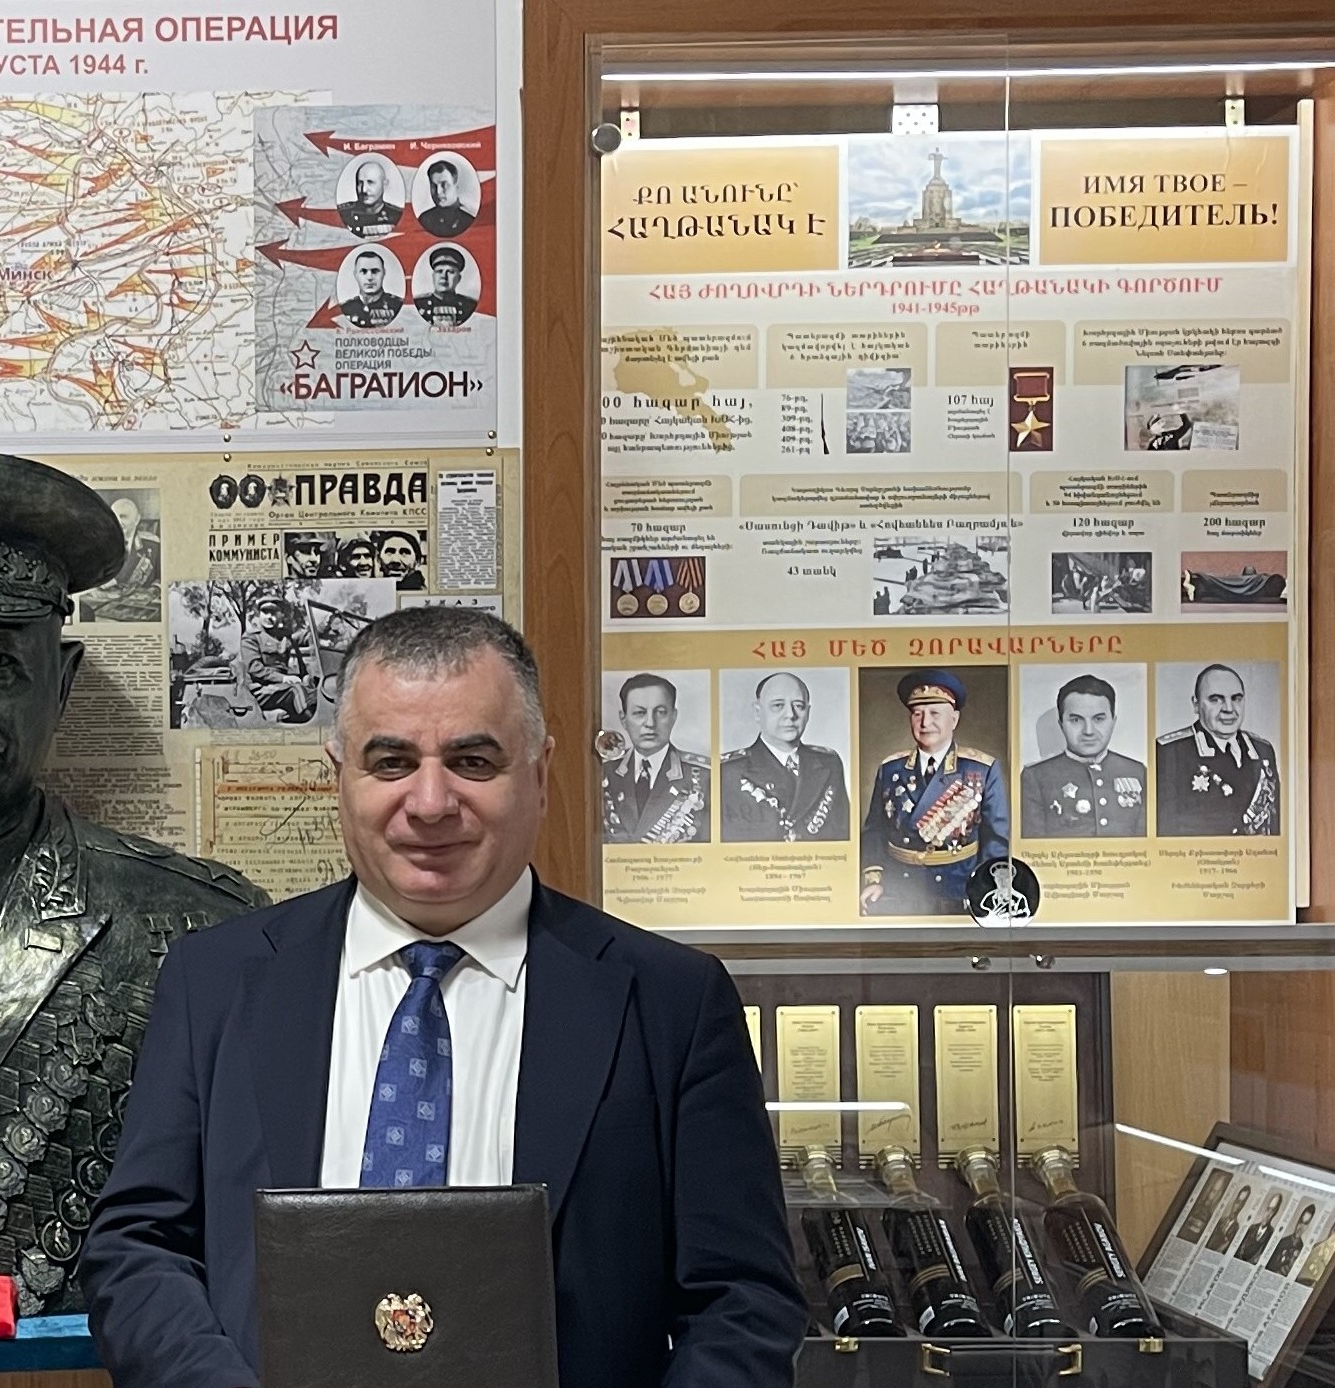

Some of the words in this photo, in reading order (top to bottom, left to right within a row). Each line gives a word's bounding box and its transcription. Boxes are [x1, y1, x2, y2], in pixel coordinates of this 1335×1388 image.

[155, 15, 339, 44] ОПЕРАЦИЯ
[68, 53, 125, 74] 1944
[134, 59, 149, 74] г.
[1083, 174, 1145, 195] ИМЯ
[1153, 173, 1226, 194] ТВОЕ
[633, 185, 671, 204] ՔՈ
[1049, 202, 1280, 230] ПОБЕДИТЕЛЬ!
[607, 213, 795, 241] ՀԱՂԹԱՆԱԿ
[806, 213, 826, 235] Է
[649, 283, 692, 300] ՀԱՅ
[698, 281, 821, 299] ԺՈՂՈՎՐԴԻ
[827, 279, 962, 298] ՆԵՐԴՐՈՒՄԸ
[967, 278, 1110, 297] ՀԱՂԹԱՆԱԿԻ
[1117, 276, 1224, 294] ԳՈՐԾՈՒՄ
[335, 337, 409, 347] ПОЛКОВОДЦЫ
[335, 348, 385, 359] ВЕЛИКОЙ
[387, 347, 432, 358] ПОБЕДЫ
[335, 360, 391, 371] ОПЕРАЦИЯ
[279, 370, 483, 400] «БАГРАТИОН»
[633, 395, 700, 411] հազար
[947, 394, 967, 405] 107
[971, 394, 994, 407] հայ
[295, 472, 427, 506] ПРАВДА
[402, 507, 427, 516] КПСС
[630, 522, 643, 533] 70
[646, 522, 686, 535] հազար
[1072, 517, 1090, 527] 120
[1093, 517, 1135, 529] հազար
[1203, 517, 1222, 527] 200
[1225, 517, 1266, 529] հազար
[209, 532, 280, 547] ПРИМЕР
[209, 547, 280, 563] КОММУНИСТА
[786, 566, 799, 576] 43
[802, 566, 837, 578] տանկ
[752, 639, 806, 660] ՀԱՅ
[829, 637, 887, 658] ՄԵԾ
[909, 634, 1123, 657] ԶՈՐԱՎԱՐՆԵՐԸ
